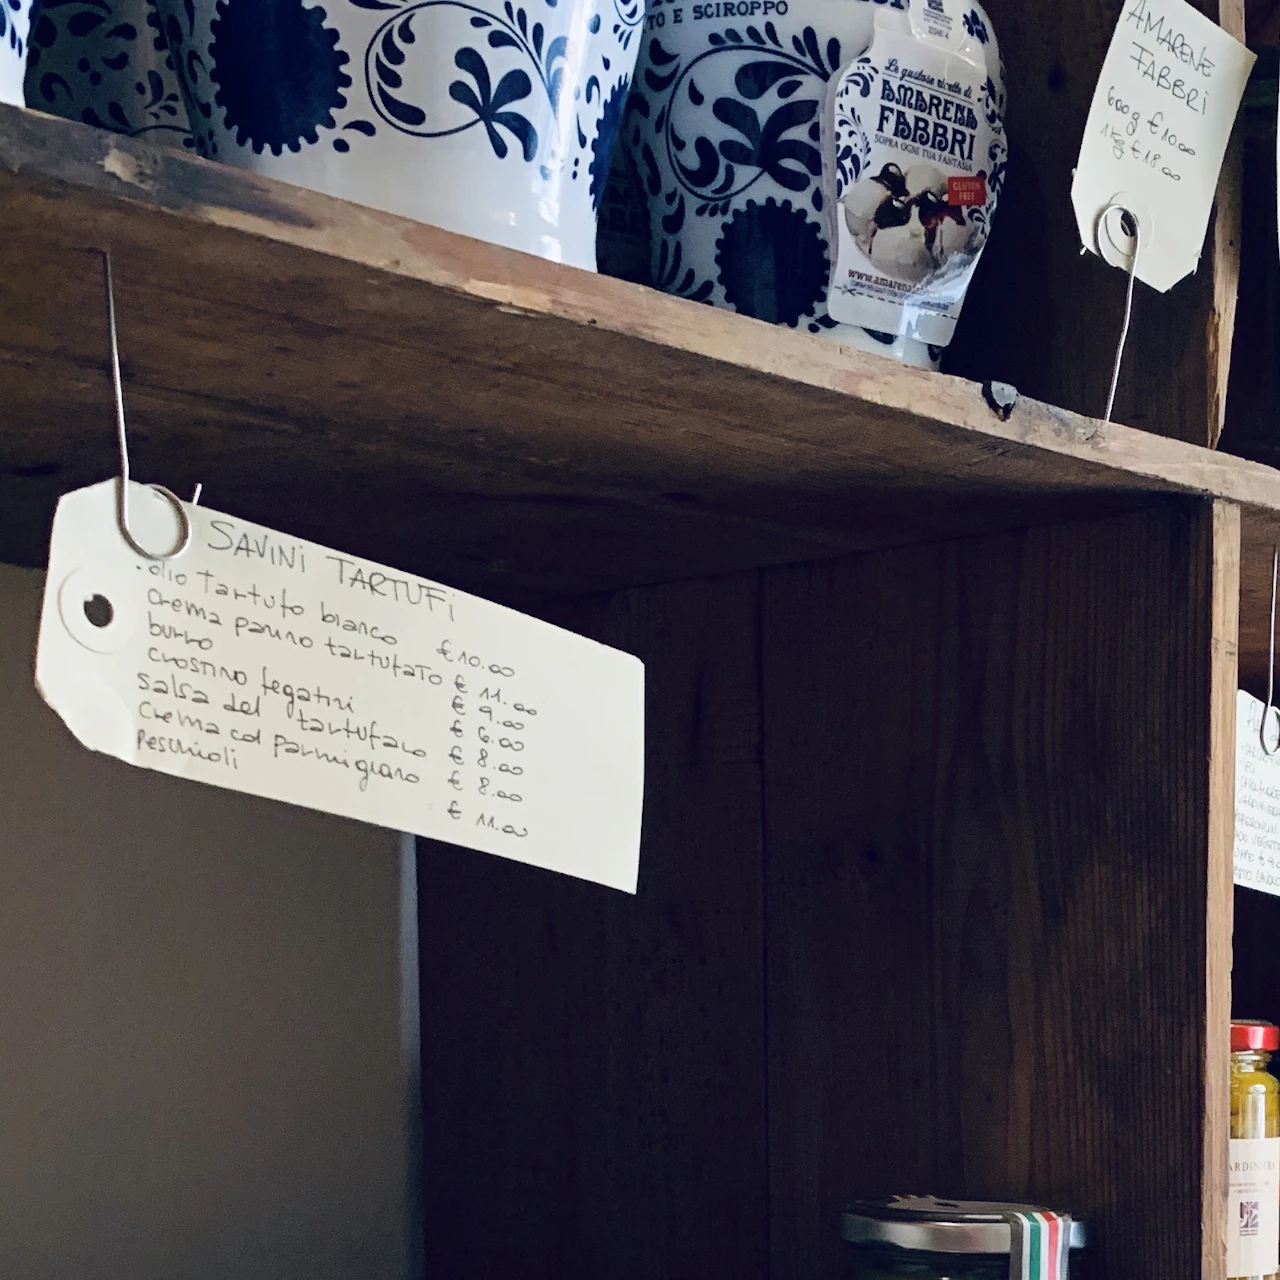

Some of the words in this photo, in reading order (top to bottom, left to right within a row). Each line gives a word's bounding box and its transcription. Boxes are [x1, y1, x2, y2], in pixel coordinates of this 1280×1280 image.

[672, 8, 683, 24] E
[693, 0, 789, 22] SCIROPPO
[1126, 0, 1216, 77] AMARENE
[880, 78, 979, 131] AMARENA
[876, 103, 976, 161] FABBRI
[874, 133, 899, 149] SOPRA
[900, 142, 921, 157] OGNI
[922, 149, 936, 161] TUA
[952, 181, 981, 192] GLUTEN
[958, 191, 975, 200] FREE
[147, 611, 214, 651] burro
[452, 698, 466, 716] €
[453, 674, 468, 693] €
[222, 693, 261, 718] del
[448, 748, 464, 766] €
[449, 720, 464, 738] €
[447, 775, 464, 792] €
[446, 800, 462, 821] €
